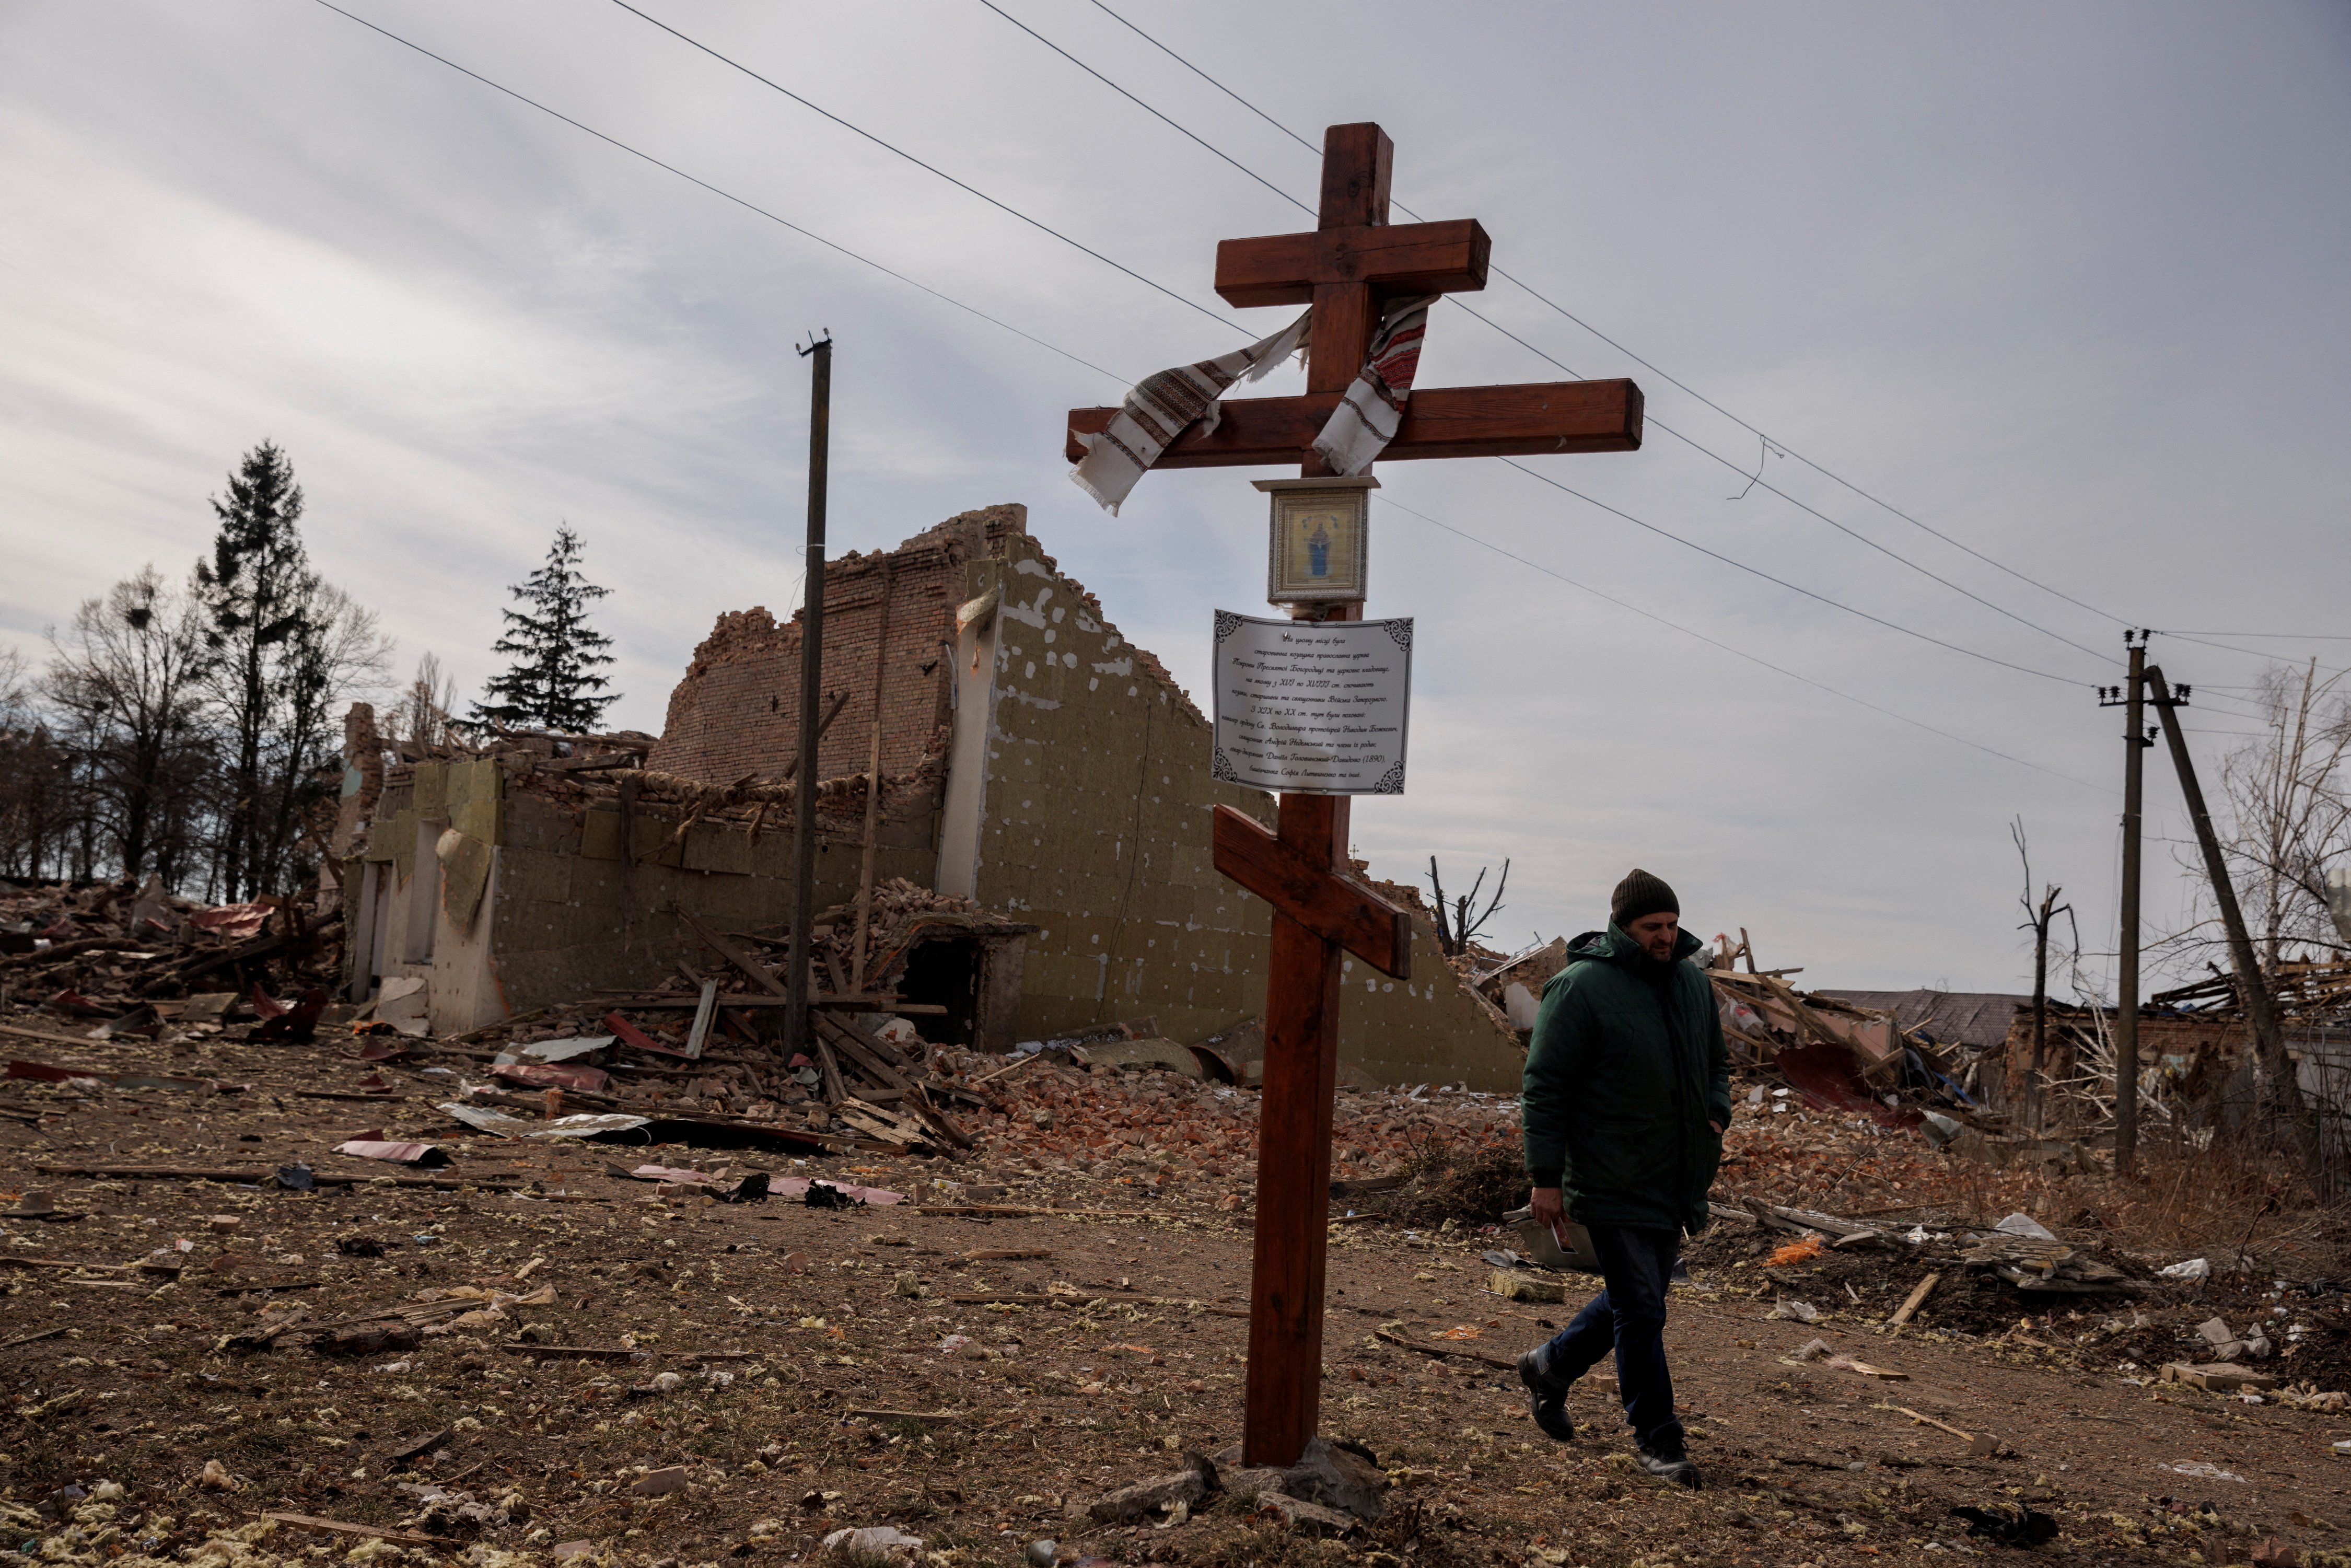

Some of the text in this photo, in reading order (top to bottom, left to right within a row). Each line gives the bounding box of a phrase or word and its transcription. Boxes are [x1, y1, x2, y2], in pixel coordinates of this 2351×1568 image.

[1332, 637, 1345, 646] була
[1232, 658, 1254, 669] Покрови
[1290, 665, 1324, 675] Богородиці
[1254, 679, 1272, 688] якому
[1353, 695, 1388, 705] Запорозького.
[1258, 706, 1273, 715] XIX
[1326, 711, 1340, 721] були
[1221, 715, 1238, 725] кавалер
[1240, 719, 1254, 729] ордену
[1268, 723, 1306, 733] Володимира
[1239, 735, 1263, 743] священник
[1265, 737, 1286, 747] Андрій
[1229, 747, 1263, 758] лікар-дворянин
[1249, 765, 1278, 774] бишівчанка
[1281, 768, 1299, 778] Софія
[1301, 769, 1336, 778] Литвиненко
